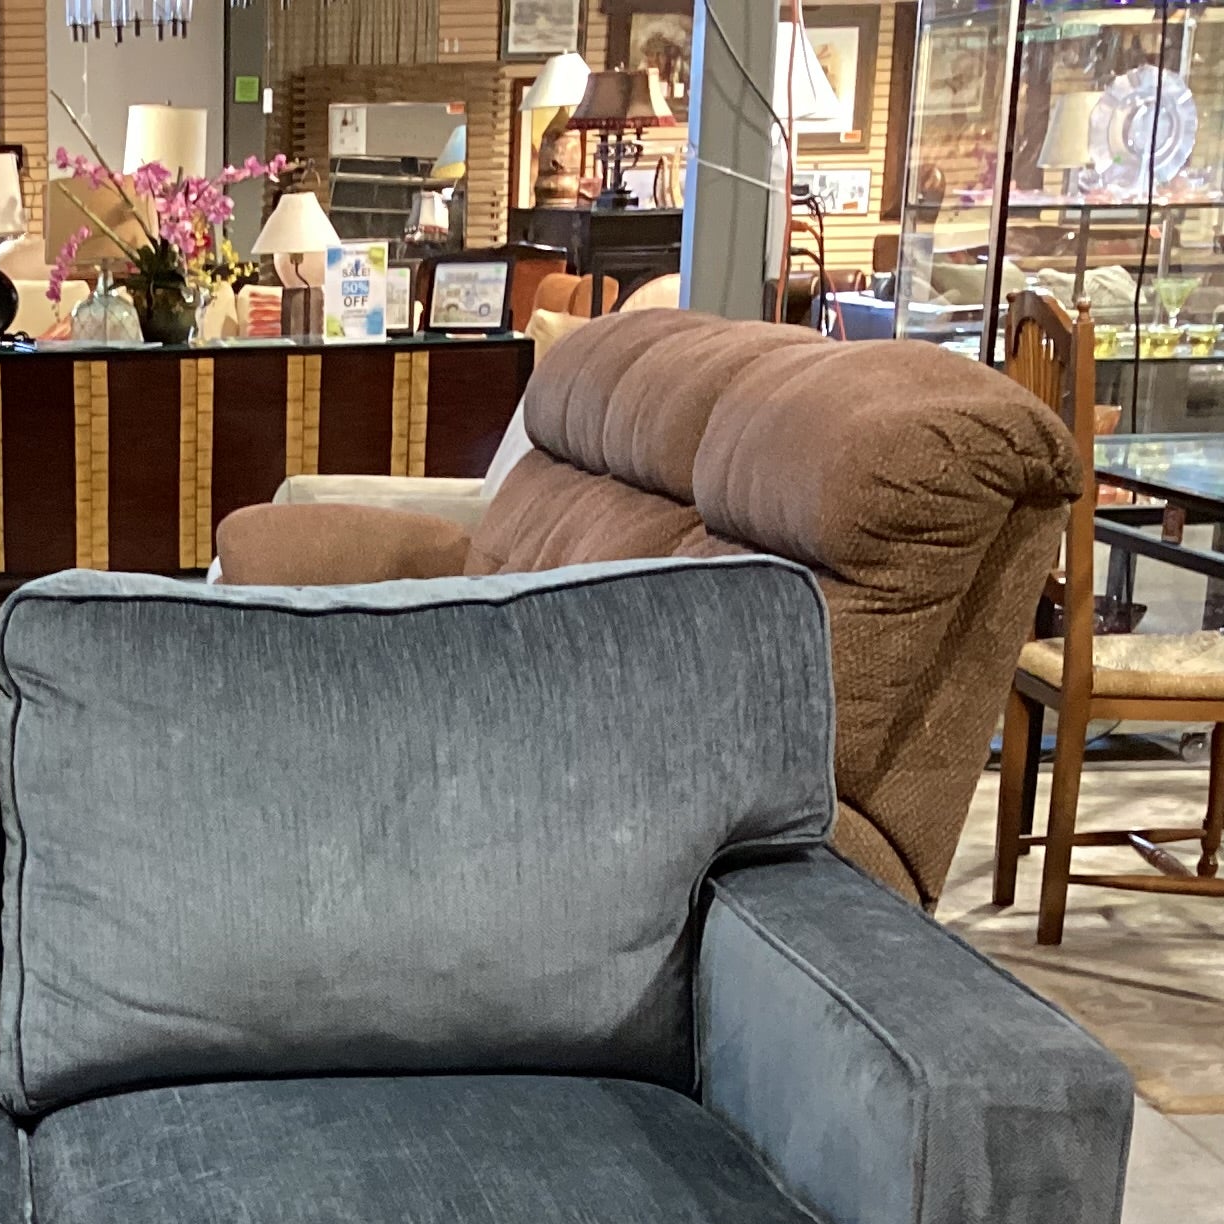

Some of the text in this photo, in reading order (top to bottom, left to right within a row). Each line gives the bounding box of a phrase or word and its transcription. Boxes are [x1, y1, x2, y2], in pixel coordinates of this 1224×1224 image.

[342, 267, 370, 277] SALE!
[343, 282, 368, 293] 50%
[343, 295, 368, 307] OFF
